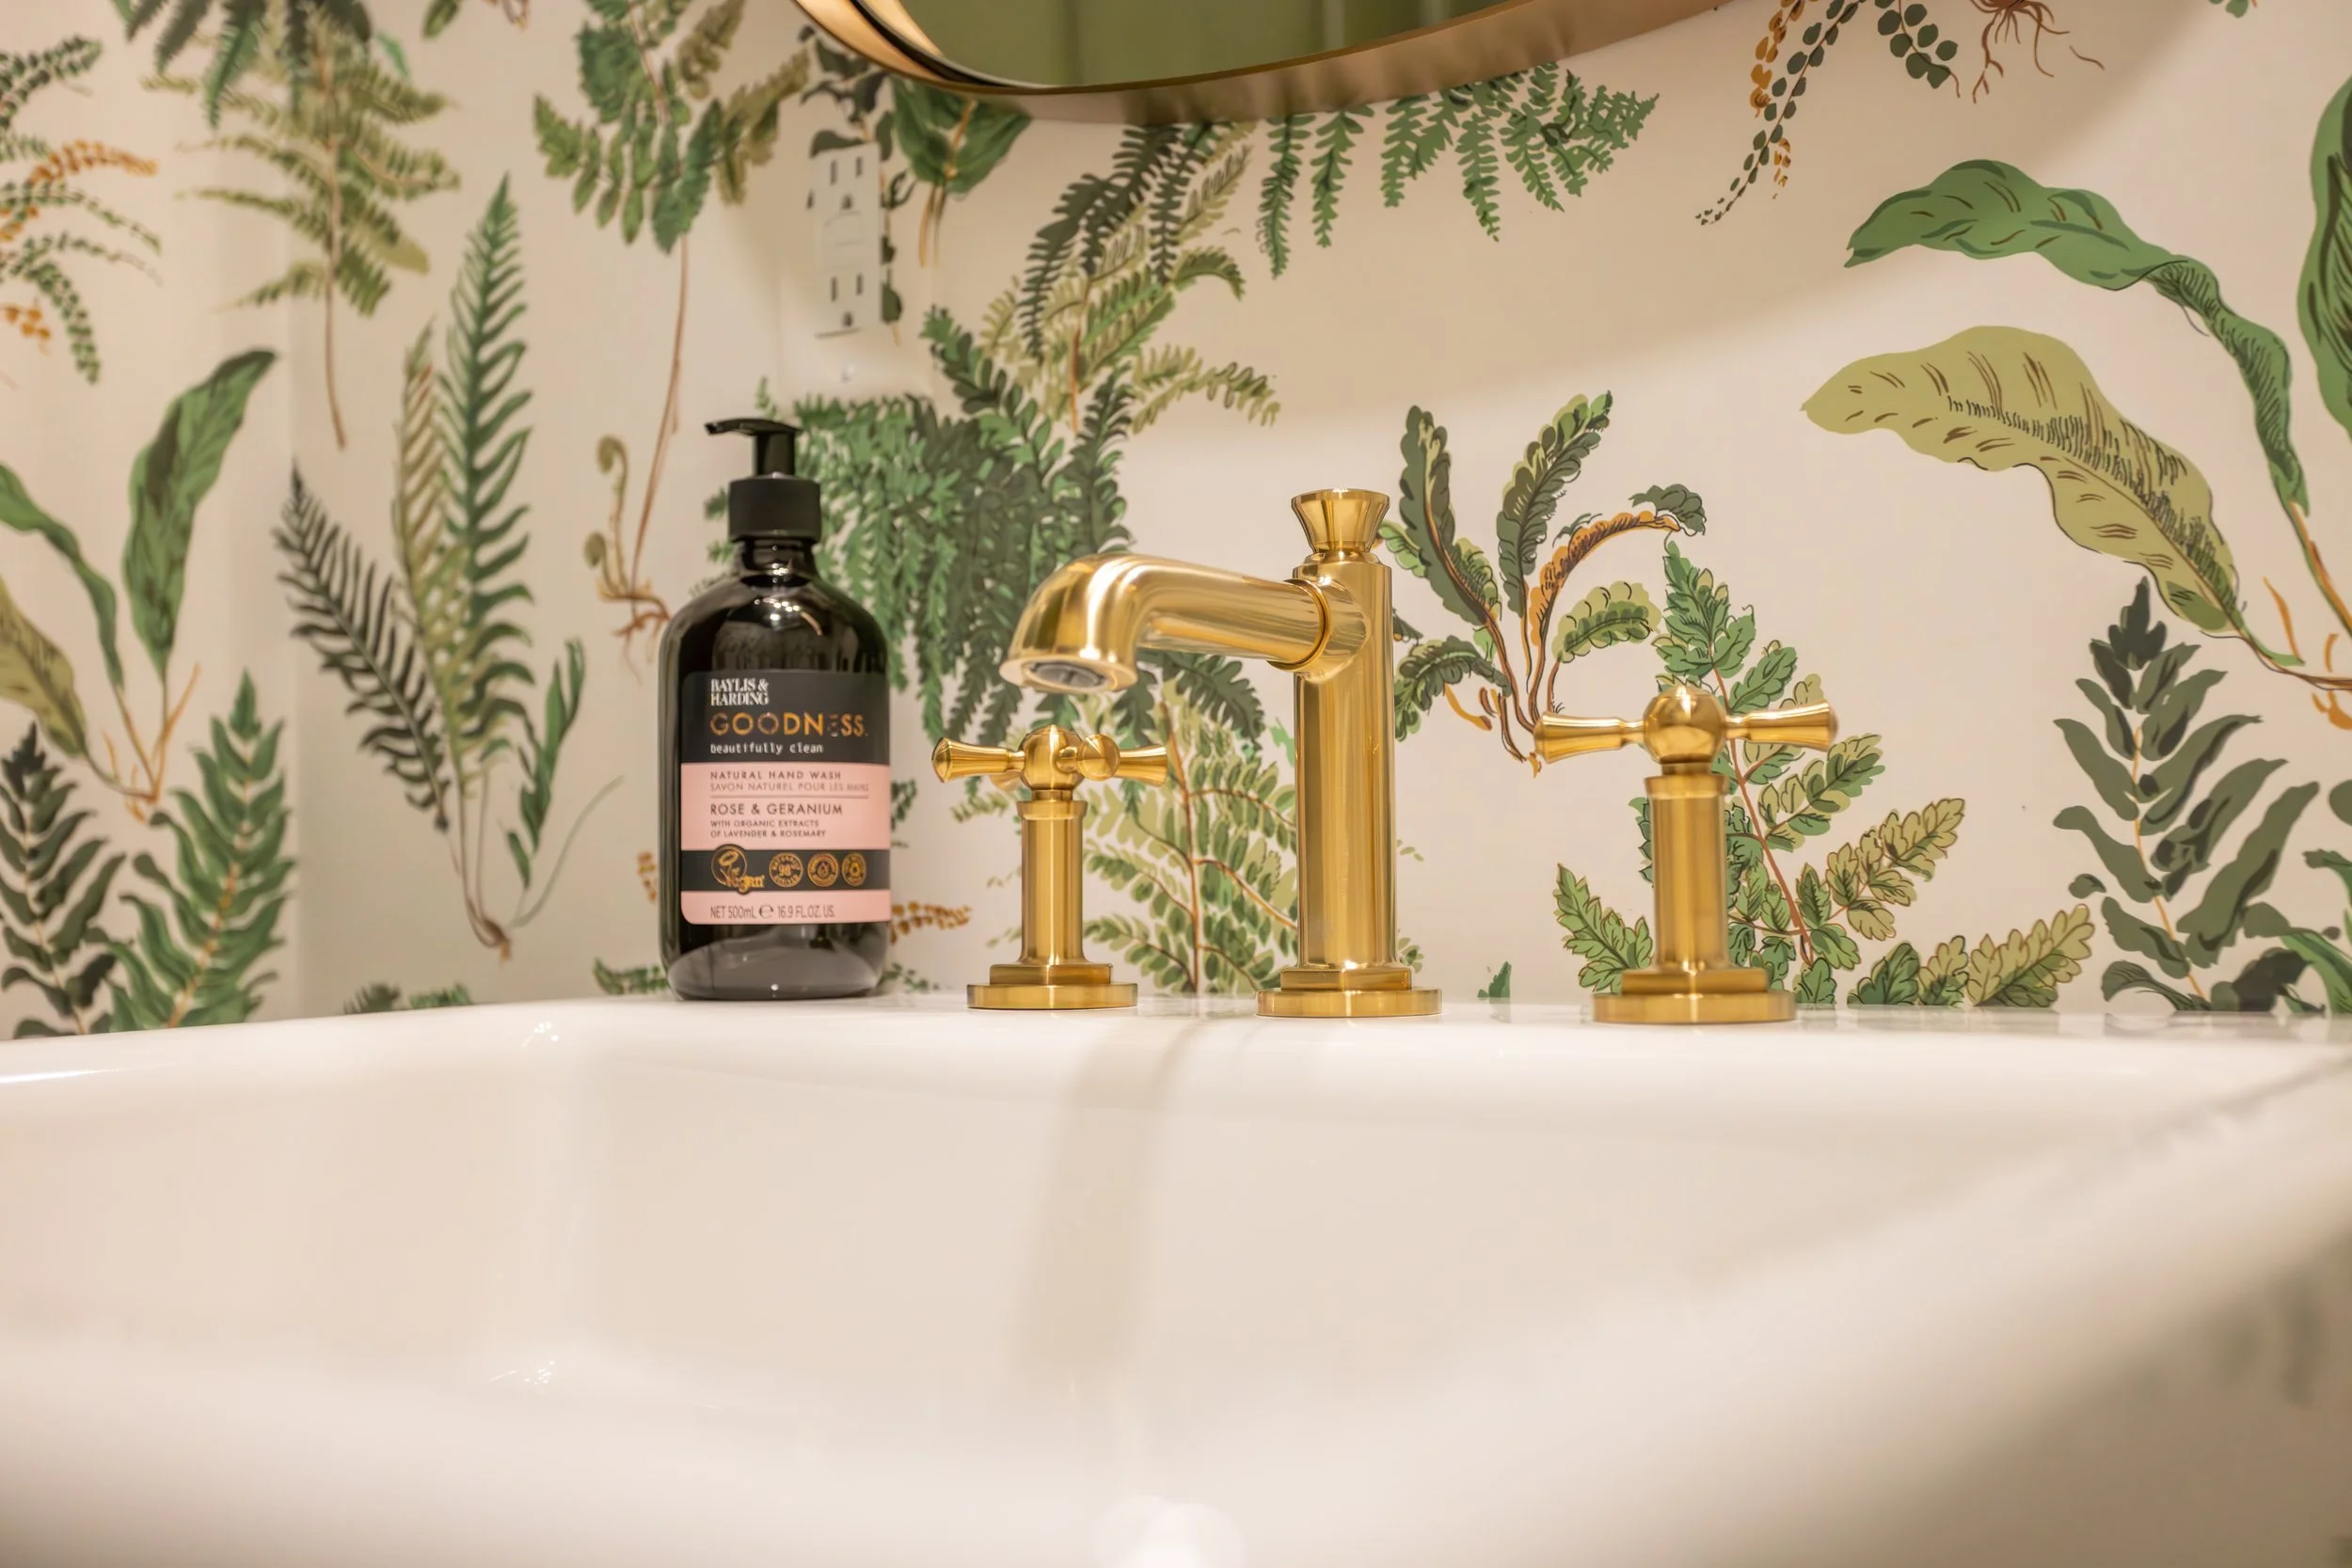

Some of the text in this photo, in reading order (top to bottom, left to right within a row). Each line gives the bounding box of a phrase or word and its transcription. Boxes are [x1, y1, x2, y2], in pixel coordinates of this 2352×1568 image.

[710, 677, 769, 692] BAYLIS &
[710, 691, 770, 706] HARDING
[710, 742, 823, 755] beautifully clean
[710, 771, 841, 780] NATURAL HAND WASH
[710, 783, 743, 792] SAVON
[748, 783, 793, 792] NATUREL
[798, 783, 825, 792] POUR
[829, 783, 844, 792] LES
[710, 803, 843, 816] ROSE & GERANIUM
[710, 830, 722, 838] OF
[723, 830, 767, 838] LAVENDER
[780, 830, 826, 838] ROSEMARY
[710, 905, 726, 919] NET
[777, 905, 794, 919] 16.9
